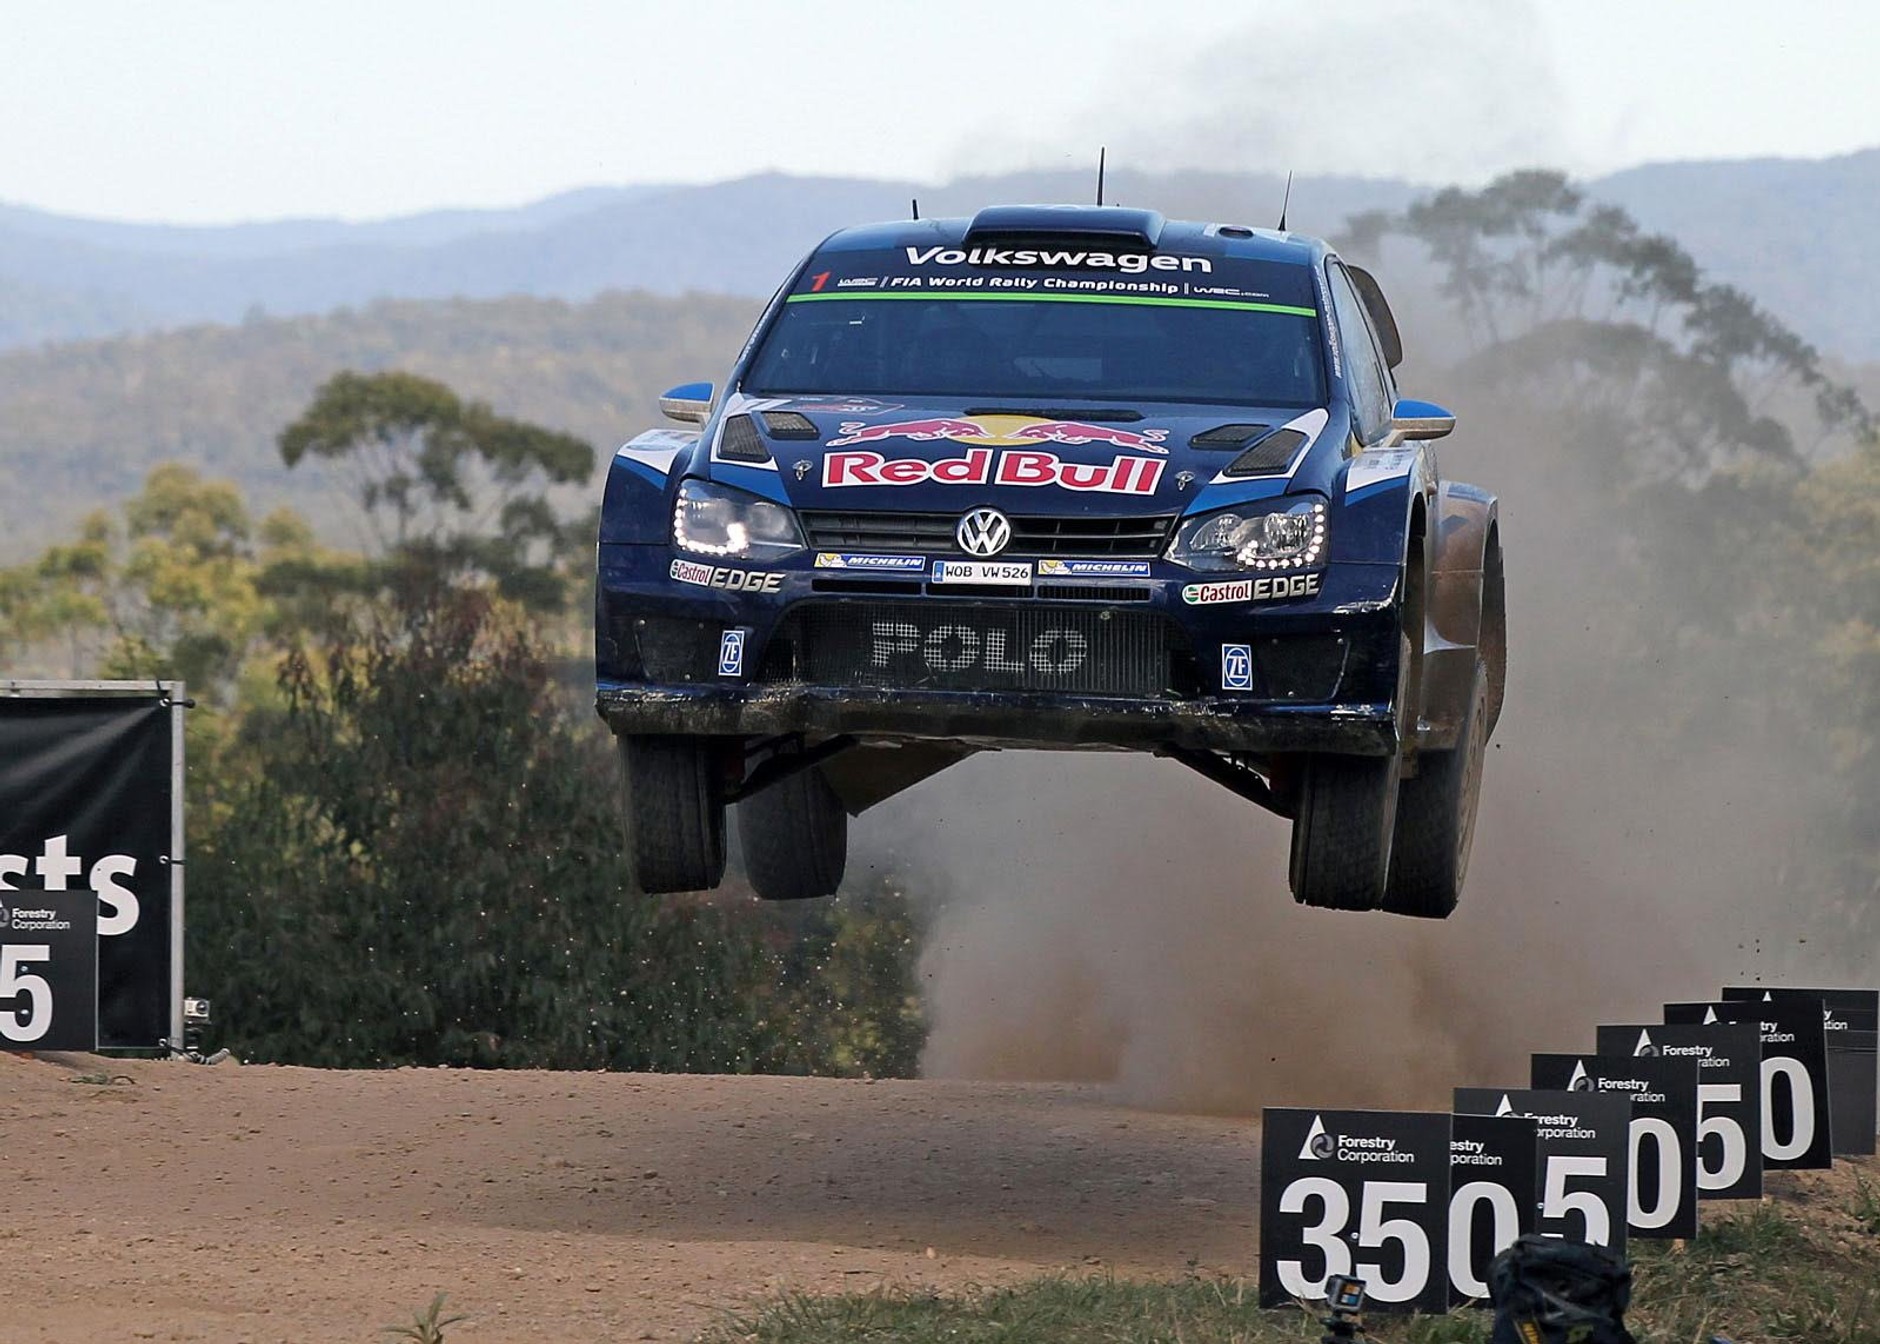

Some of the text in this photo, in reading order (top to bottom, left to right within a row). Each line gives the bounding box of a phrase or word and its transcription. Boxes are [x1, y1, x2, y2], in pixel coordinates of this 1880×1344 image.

[906, 247, 1213, 273] Volkswagen
[811, 271, 832, 291] 1
[891, 277, 922, 287] FIA
[929, 277, 983, 287] World
[989, 277, 1037, 290] Rally
[1043, 278, 1178, 294] Championship
[825, 450, 1164, 493] Red Bull
[847, 556, 922, 566] MICHELIN
[1071, 563, 1147, 573] MICHELIN
[677, 562, 786, 593] Castrol EDGE
[945, 566, 973, 577] WOB
[1200, 573, 1320, 602] Castrol EDGE
[873, 622, 1087, 674] POLO
[12, 908, 56, 920] Forestry
[12, 919, 71, 930] Corporation
[1663, 1045, 1713, 1057] Forestry
[1698, 1057, 1730, 1067] ration
[1598, 1077, 1650, 1092] Forestry
[1524, 1113, 1579, 1127] restry
[1337, 1135, 1396, 1150] Forestry
[1450, 1140, 1484, 1154] estry
[1337, 1149, 1414, 1163] Corporation
[1450, 1153, 1503, 1166] poration
[1276, 1177, 1430, 1302] 350
